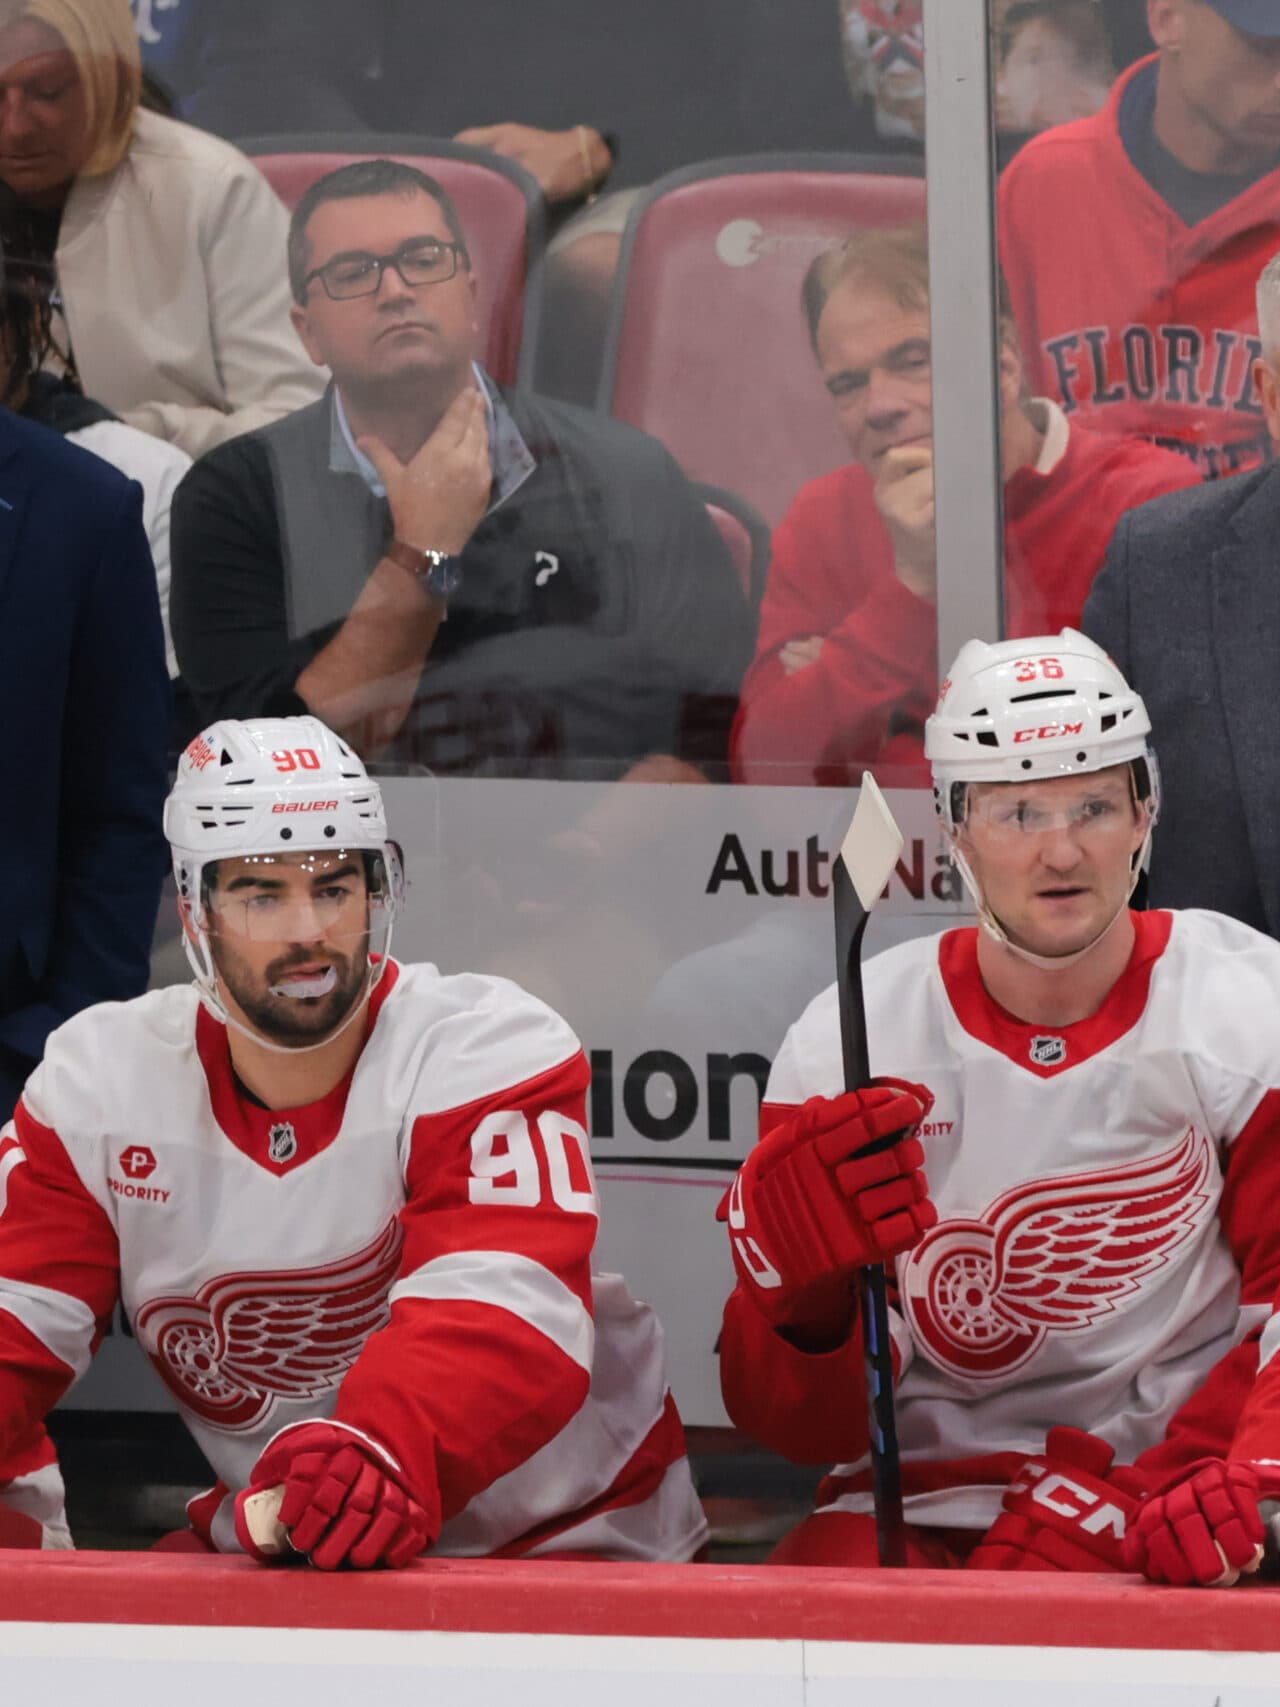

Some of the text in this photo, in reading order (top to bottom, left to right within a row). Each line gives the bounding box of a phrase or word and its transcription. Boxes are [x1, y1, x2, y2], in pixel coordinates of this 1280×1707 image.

[1043, 324, 1264, 415] FLORI
[1013, 657, 1065, 682] 36
[1013, 721, 1084, 744] CCM
[272, 748, 321, 773] 90
[913, 1122, 954, 1138] ORITY
[468, 1109, 602, 1216] 90
[106, 1177, 171, 1204] PRIORITY
